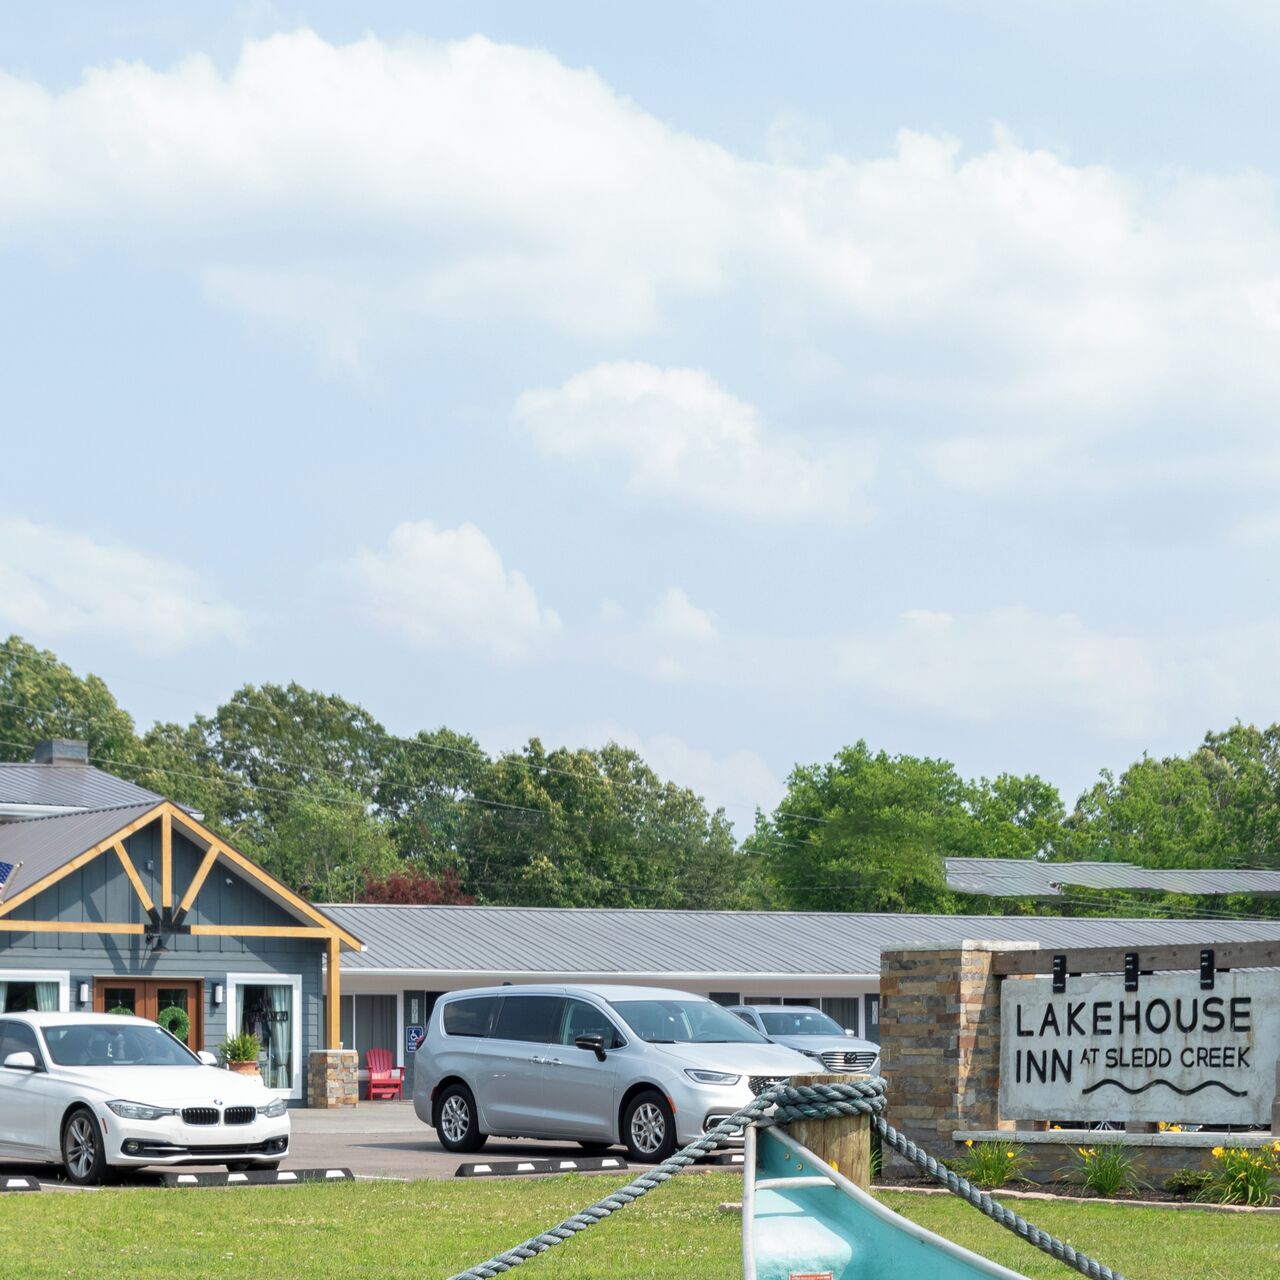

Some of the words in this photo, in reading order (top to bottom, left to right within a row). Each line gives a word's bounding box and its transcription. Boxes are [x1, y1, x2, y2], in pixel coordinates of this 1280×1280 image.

[1016, 996, 1252, 1037] LAKEHOUSE
[1015, 1048, 1073, 1084] INN
[1080, 1048, 1100, 1065] AT
[1105, 1047, 1172, 1069] SLEDD
[1180, 1046, 1252, 1069] CREEK
